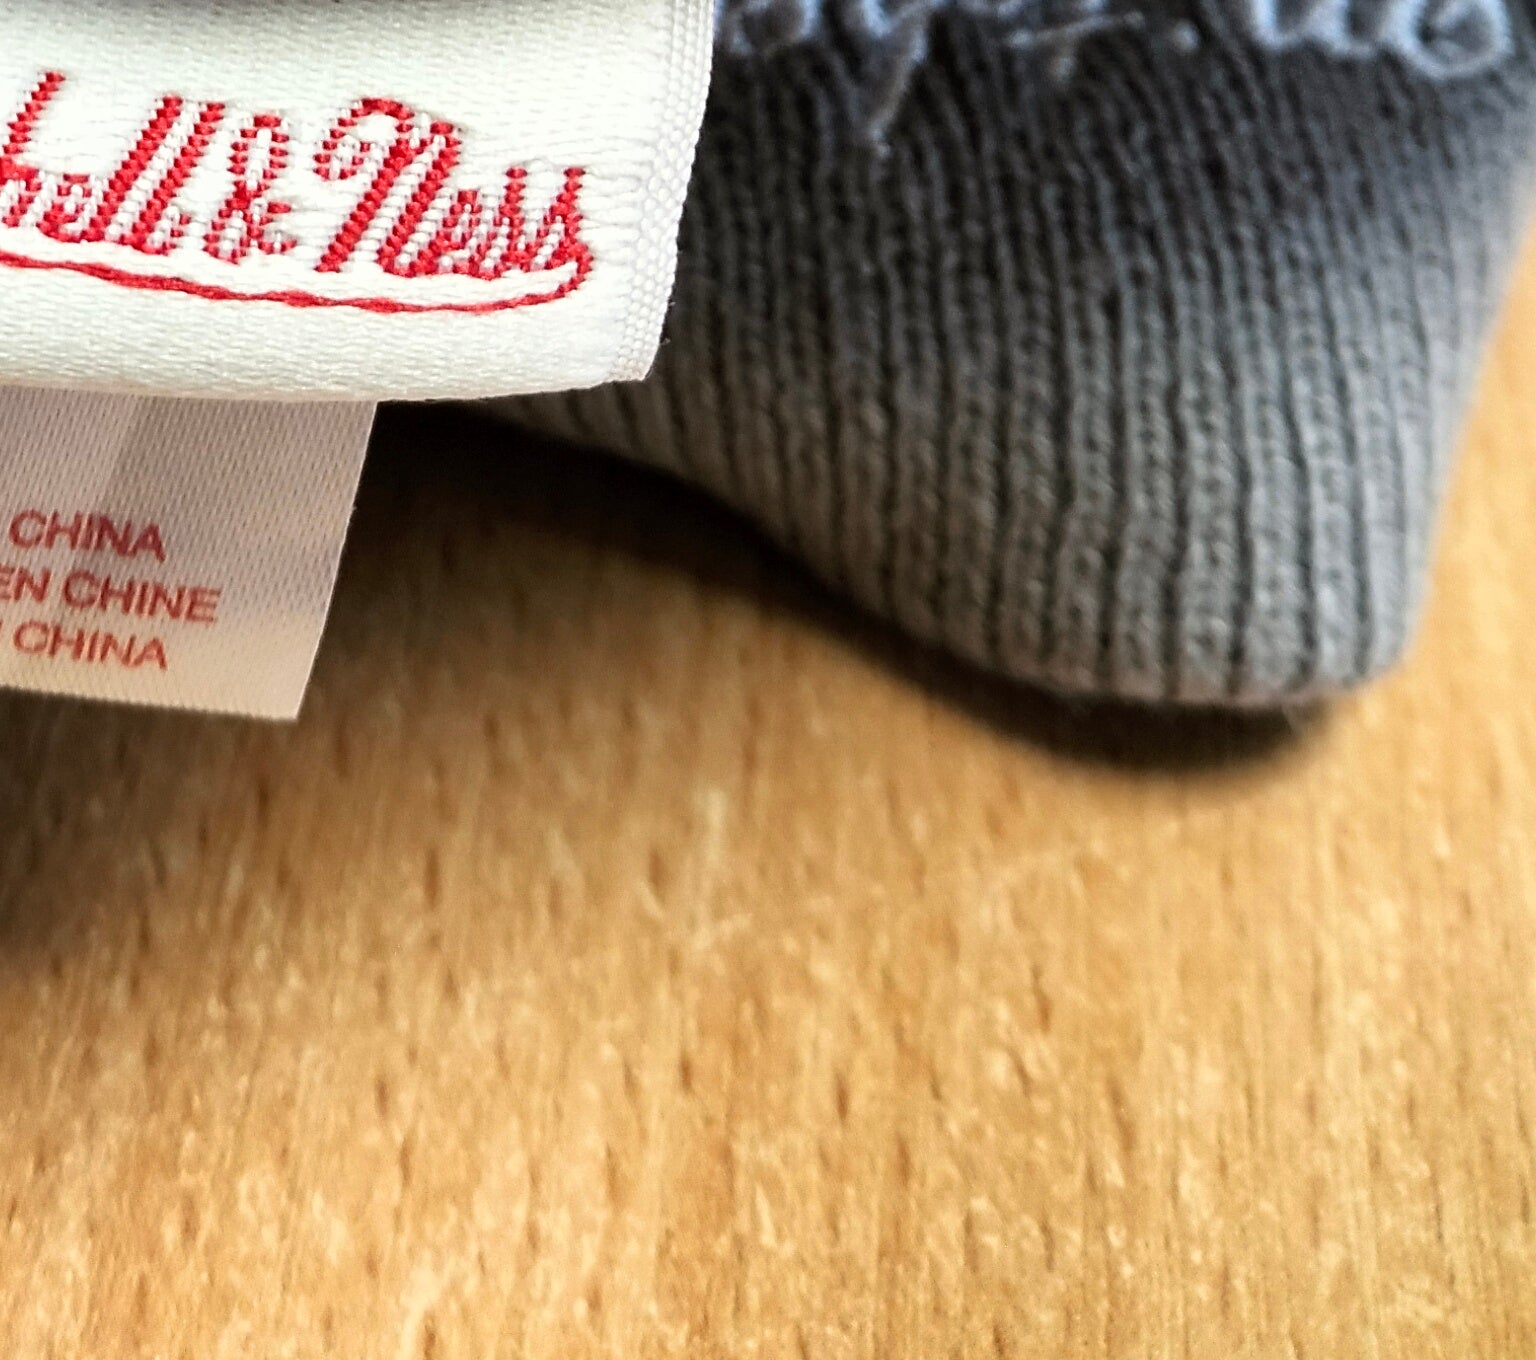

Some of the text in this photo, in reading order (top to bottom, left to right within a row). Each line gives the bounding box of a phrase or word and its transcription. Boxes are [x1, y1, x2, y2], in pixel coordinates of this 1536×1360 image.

[204, 112, 296, 265] &
[312, 96, 594, 280] Ness
[8, 509, 166, 562] CHINA
[64, 569, 221, 623] CHINE
[14, 621, 169, 671] CHINA
